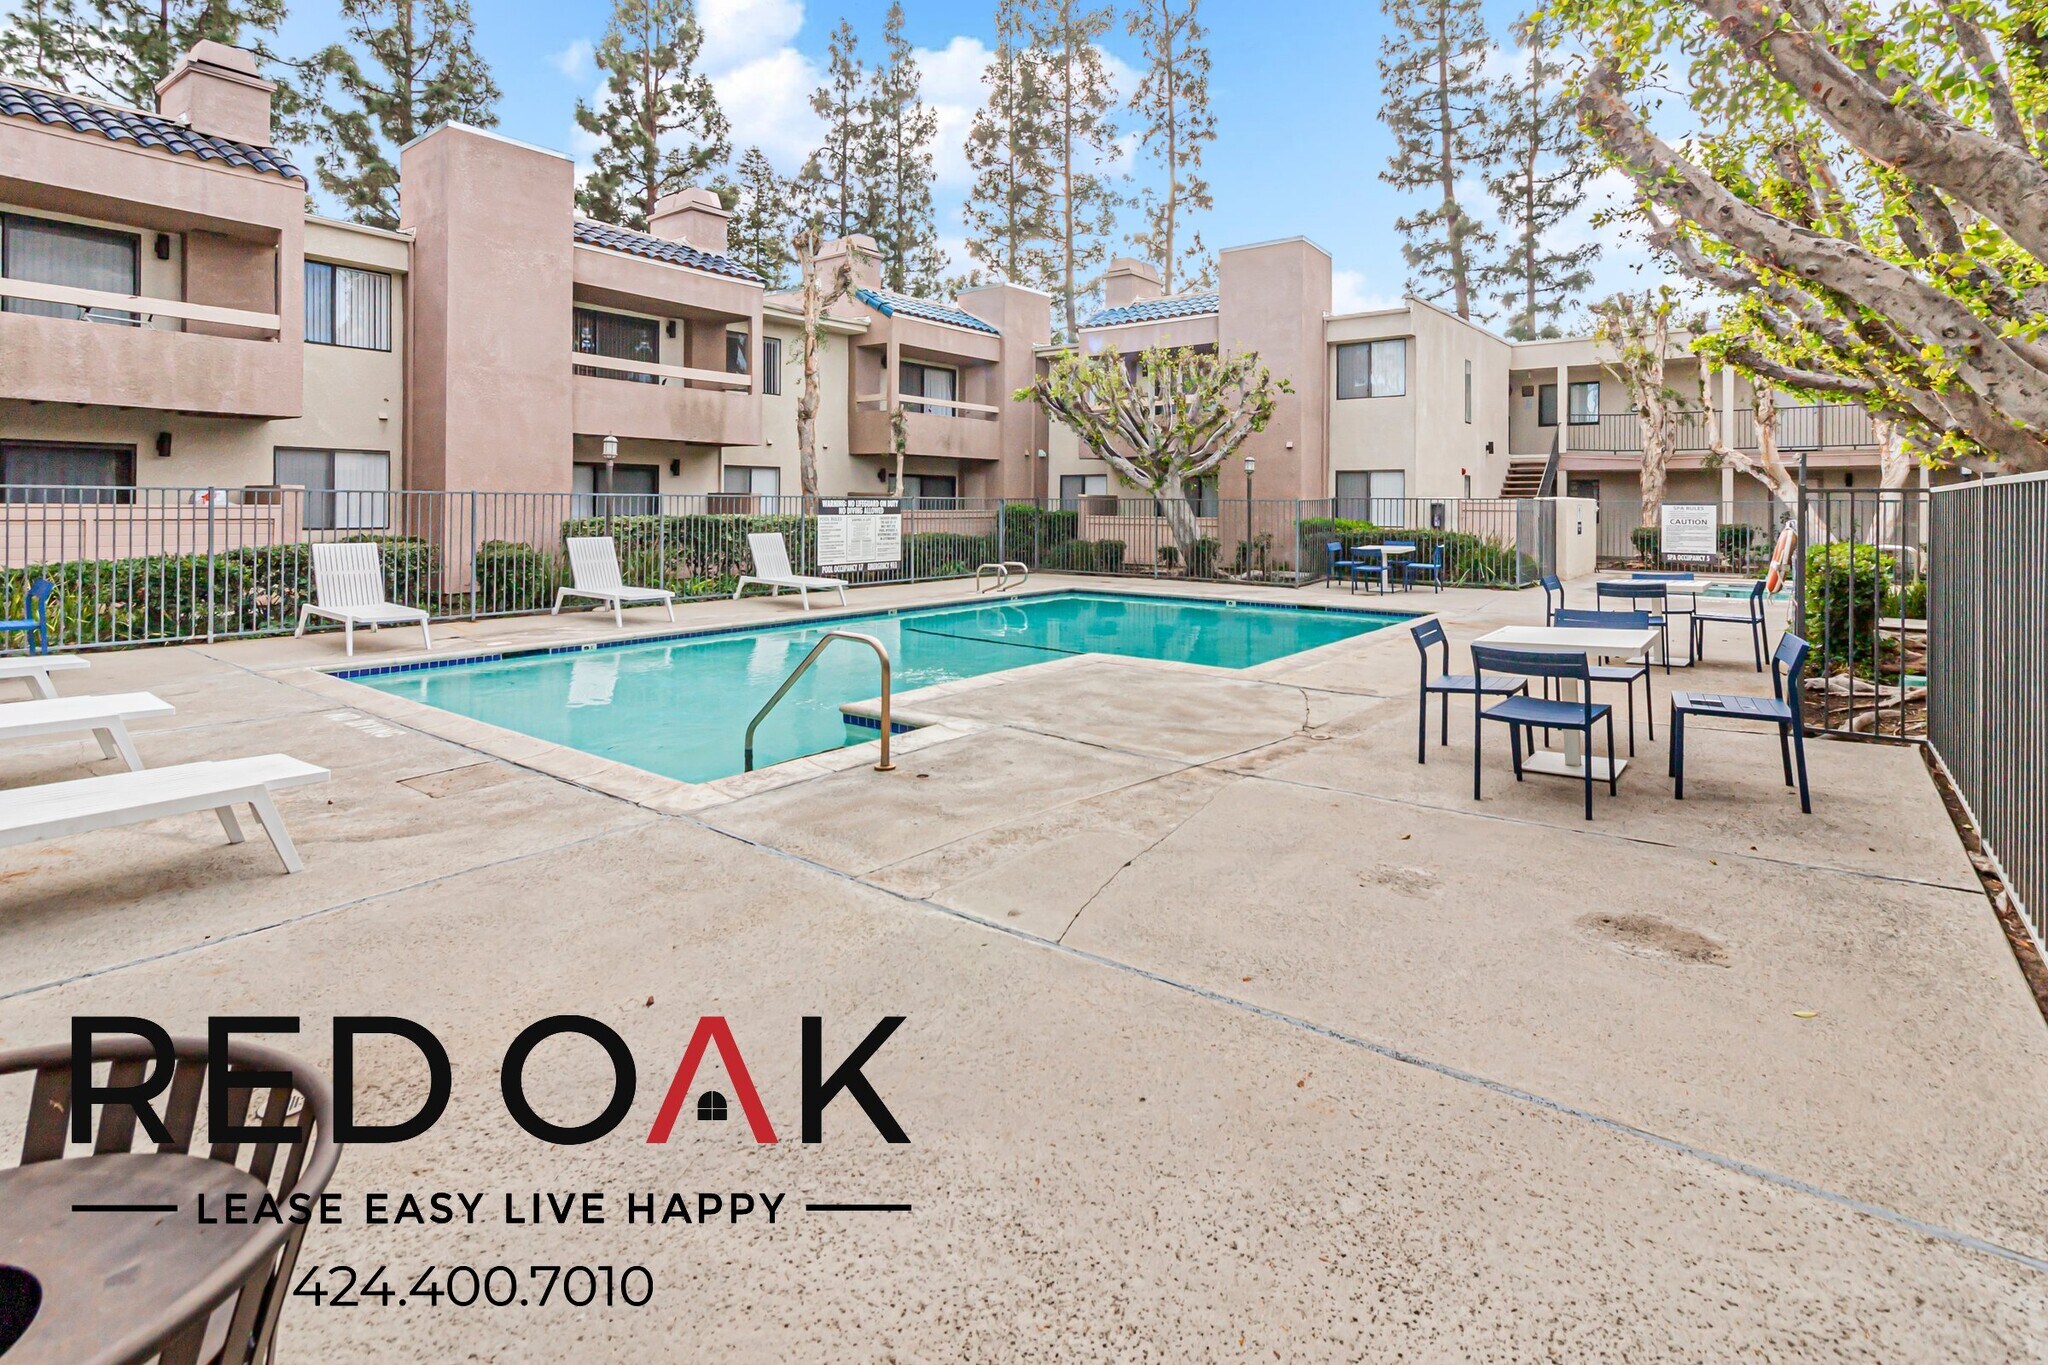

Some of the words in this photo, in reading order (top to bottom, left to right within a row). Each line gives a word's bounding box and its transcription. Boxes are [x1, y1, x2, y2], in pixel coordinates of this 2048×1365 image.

[822, 566, 834, 574] POOL
[834, 564, 857, 573] OCCUPANCY
[858, 563, 864, 571] 17
